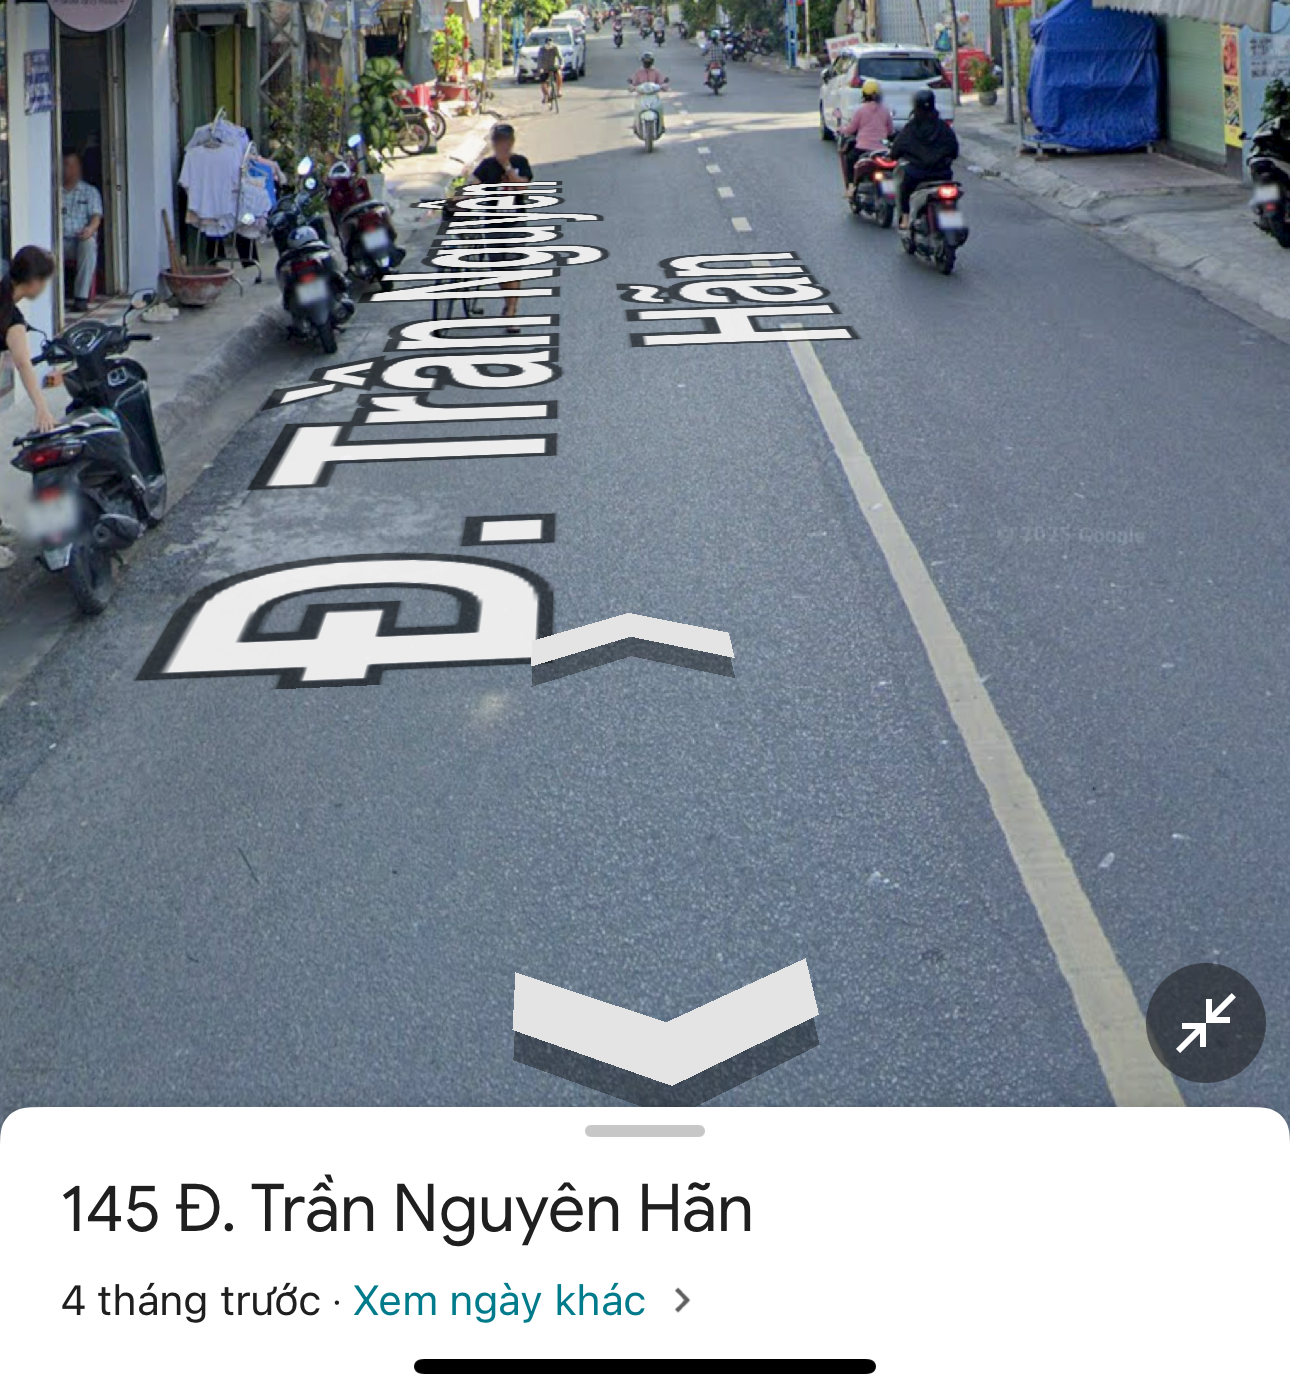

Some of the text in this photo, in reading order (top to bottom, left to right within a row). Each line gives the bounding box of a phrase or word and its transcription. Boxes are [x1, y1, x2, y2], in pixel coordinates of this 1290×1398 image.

[62, 1174, 751, 1247] 145 Đ. Trần Nguyên Hãn
[61, 1283, 646, 1323] 4 tháng trước Xem ngày khác
